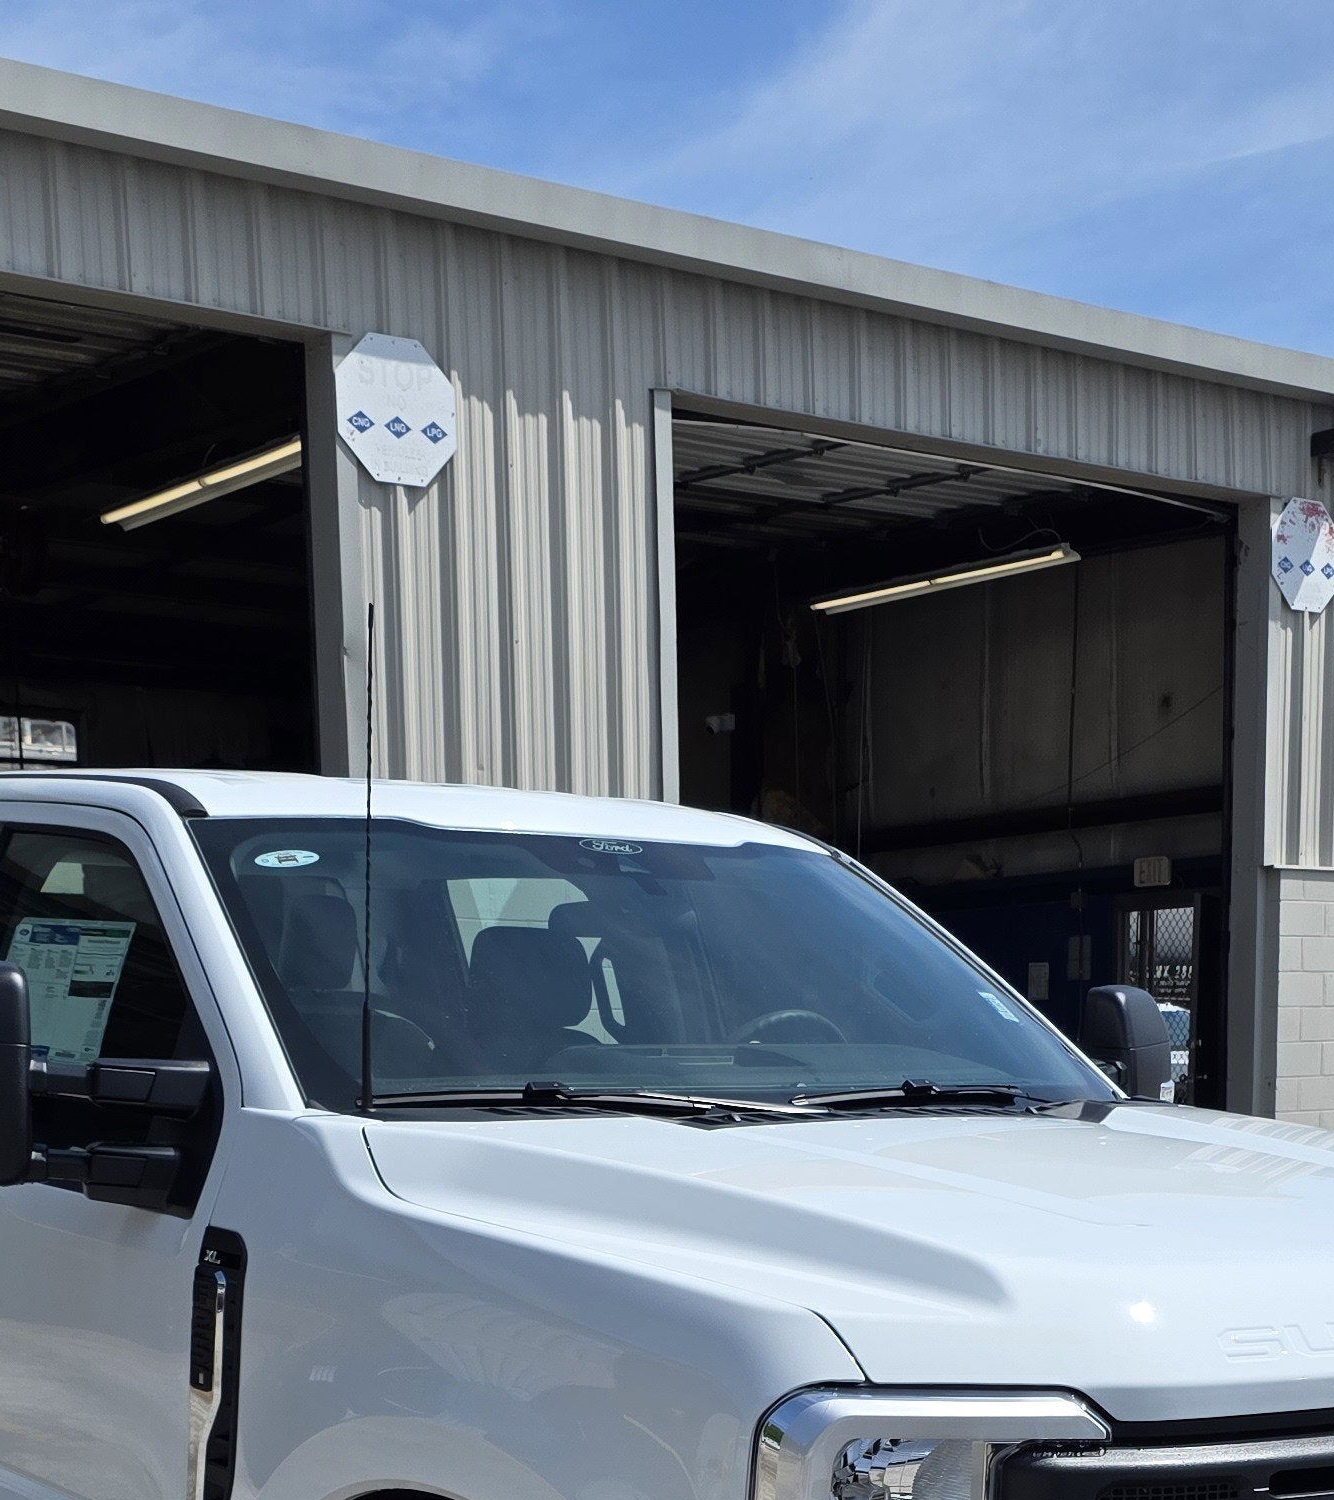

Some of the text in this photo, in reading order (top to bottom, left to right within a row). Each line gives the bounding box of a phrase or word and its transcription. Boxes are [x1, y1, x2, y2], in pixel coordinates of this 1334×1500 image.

[426, 428, 443, 438] LPG
[592, 840, 633, 852] Ford
[204, 1249, 221, 1265] XL
